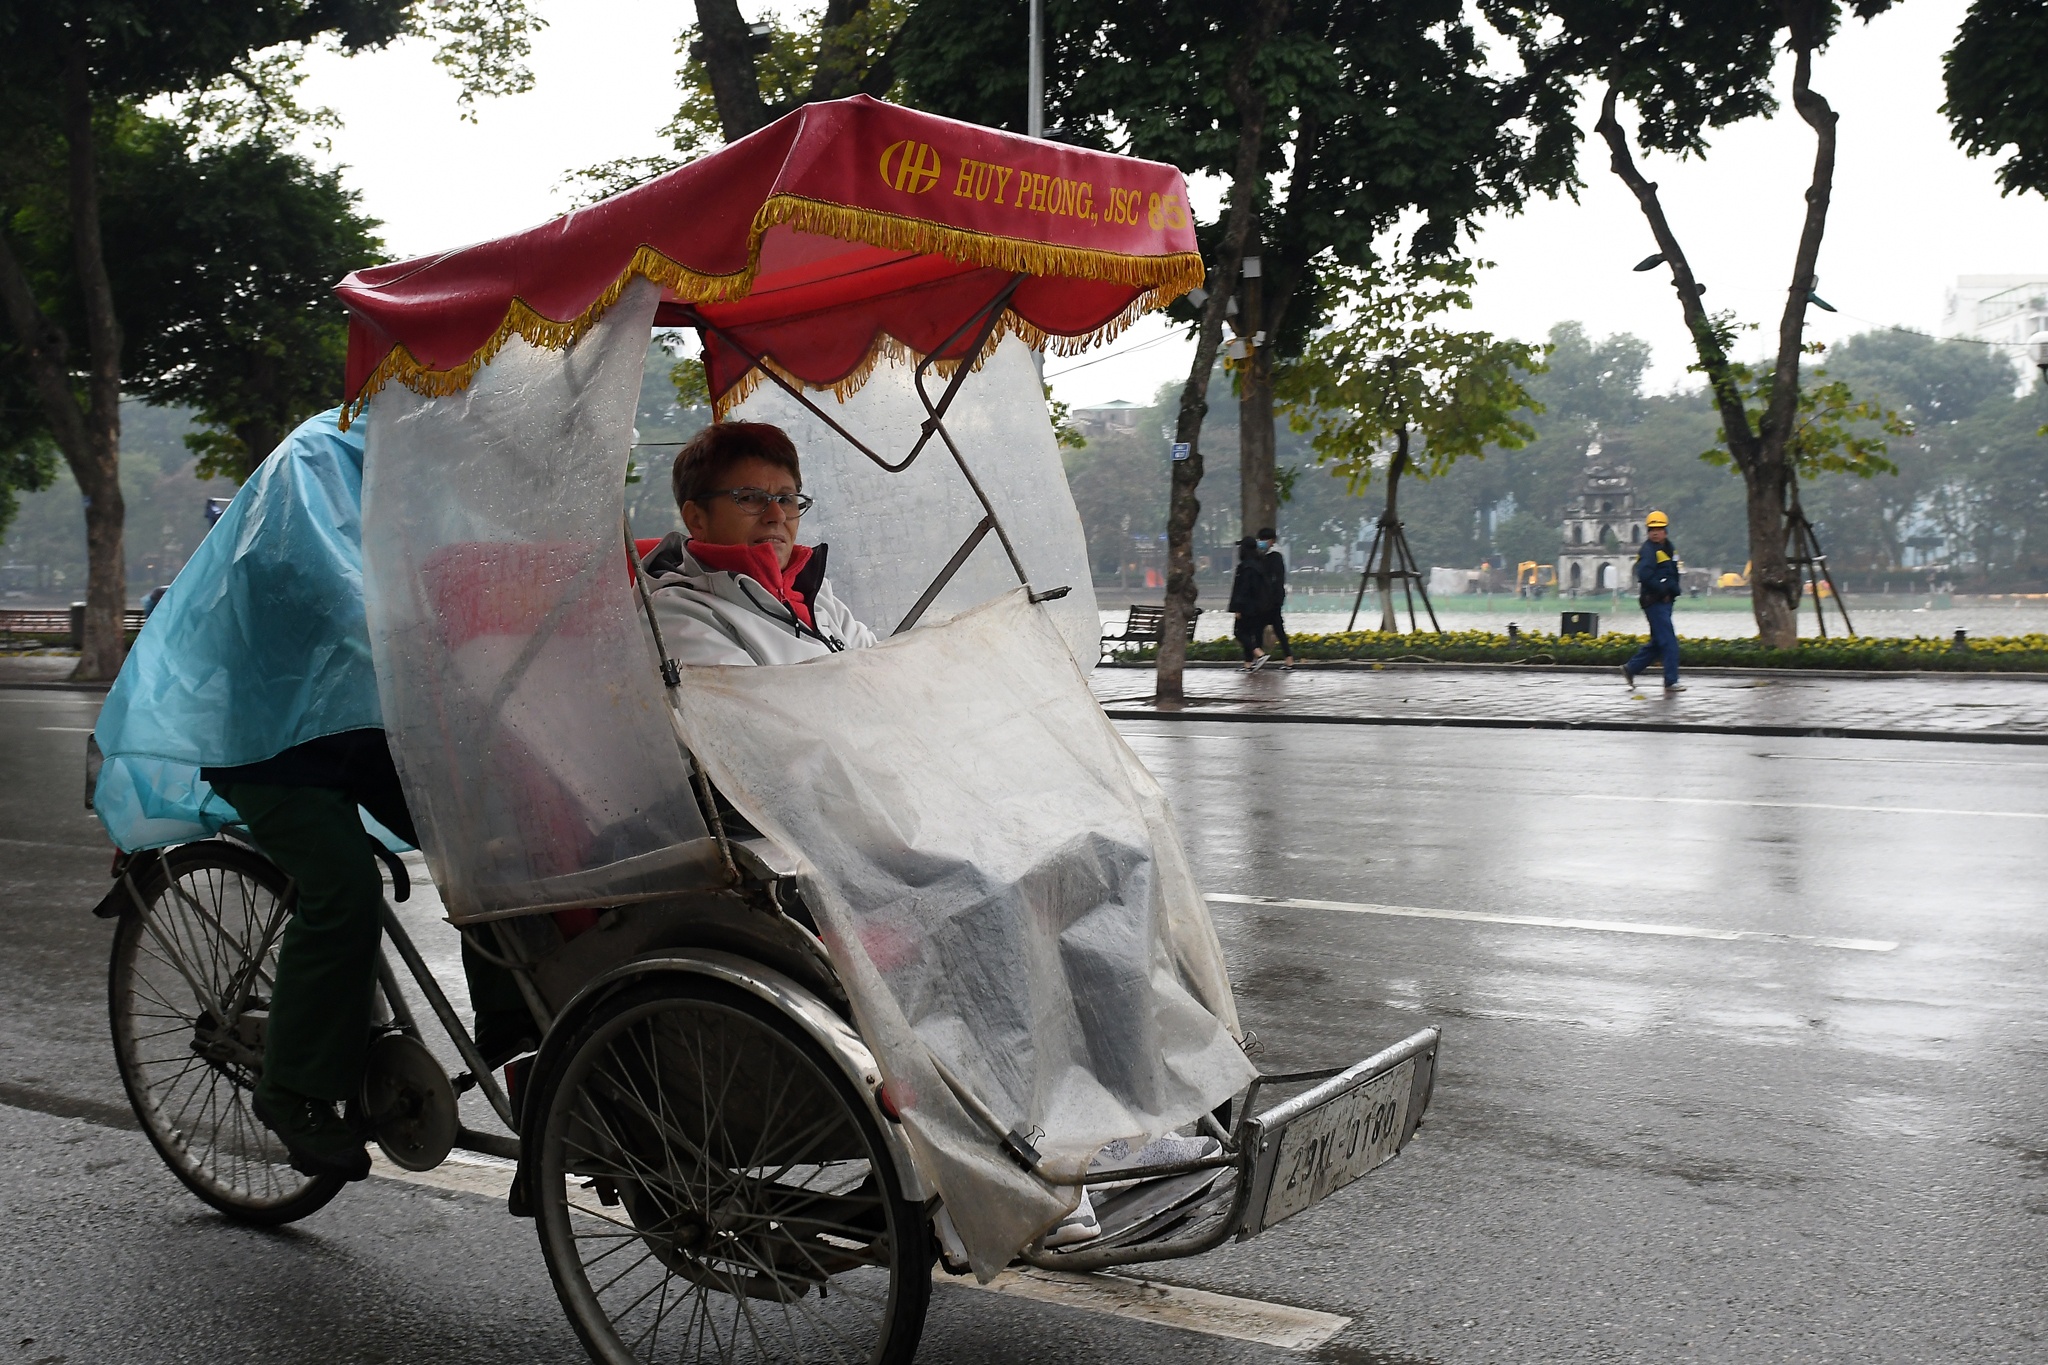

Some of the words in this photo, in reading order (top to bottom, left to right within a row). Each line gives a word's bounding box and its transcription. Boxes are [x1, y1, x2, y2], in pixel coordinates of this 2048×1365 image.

[953, 157, 1014, 205] HUY
[1103, 187, 1143, 226] JSC
[1147, 191, 1187, 231] 85
